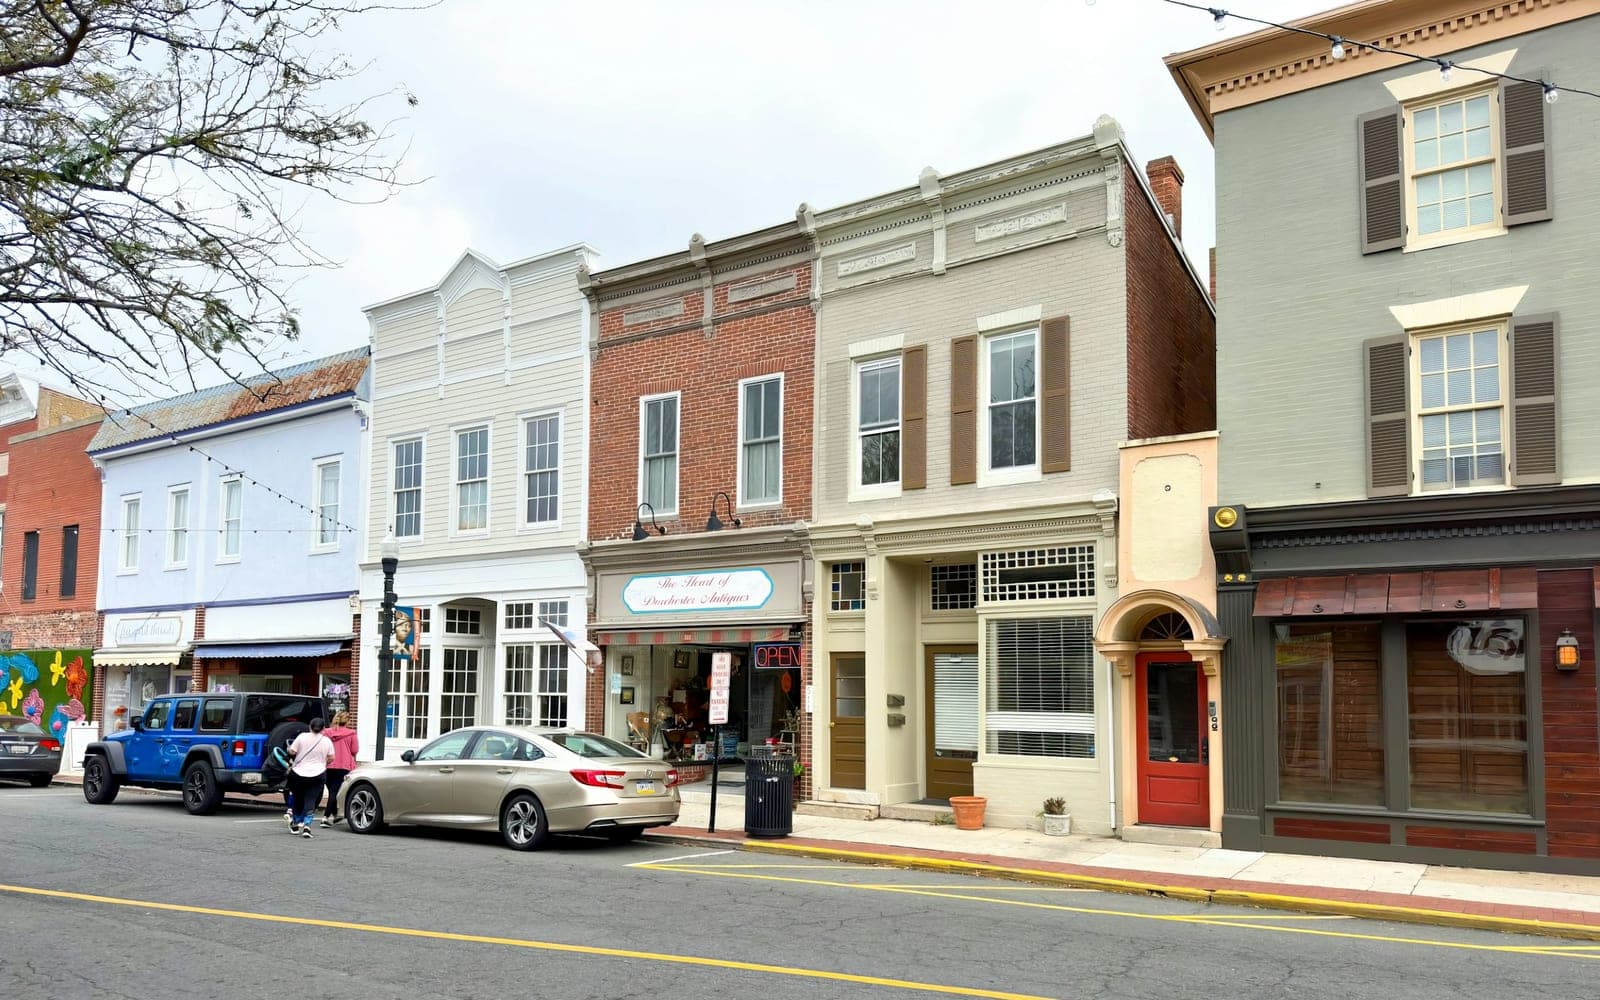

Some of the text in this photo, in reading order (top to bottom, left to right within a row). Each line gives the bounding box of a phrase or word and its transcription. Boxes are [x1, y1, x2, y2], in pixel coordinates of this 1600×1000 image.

[657, 574, 733, 588] The Heart of
[642, 591, 750, 606] Dorchester Antiques
[757, 646, 802, 666] OPEN
